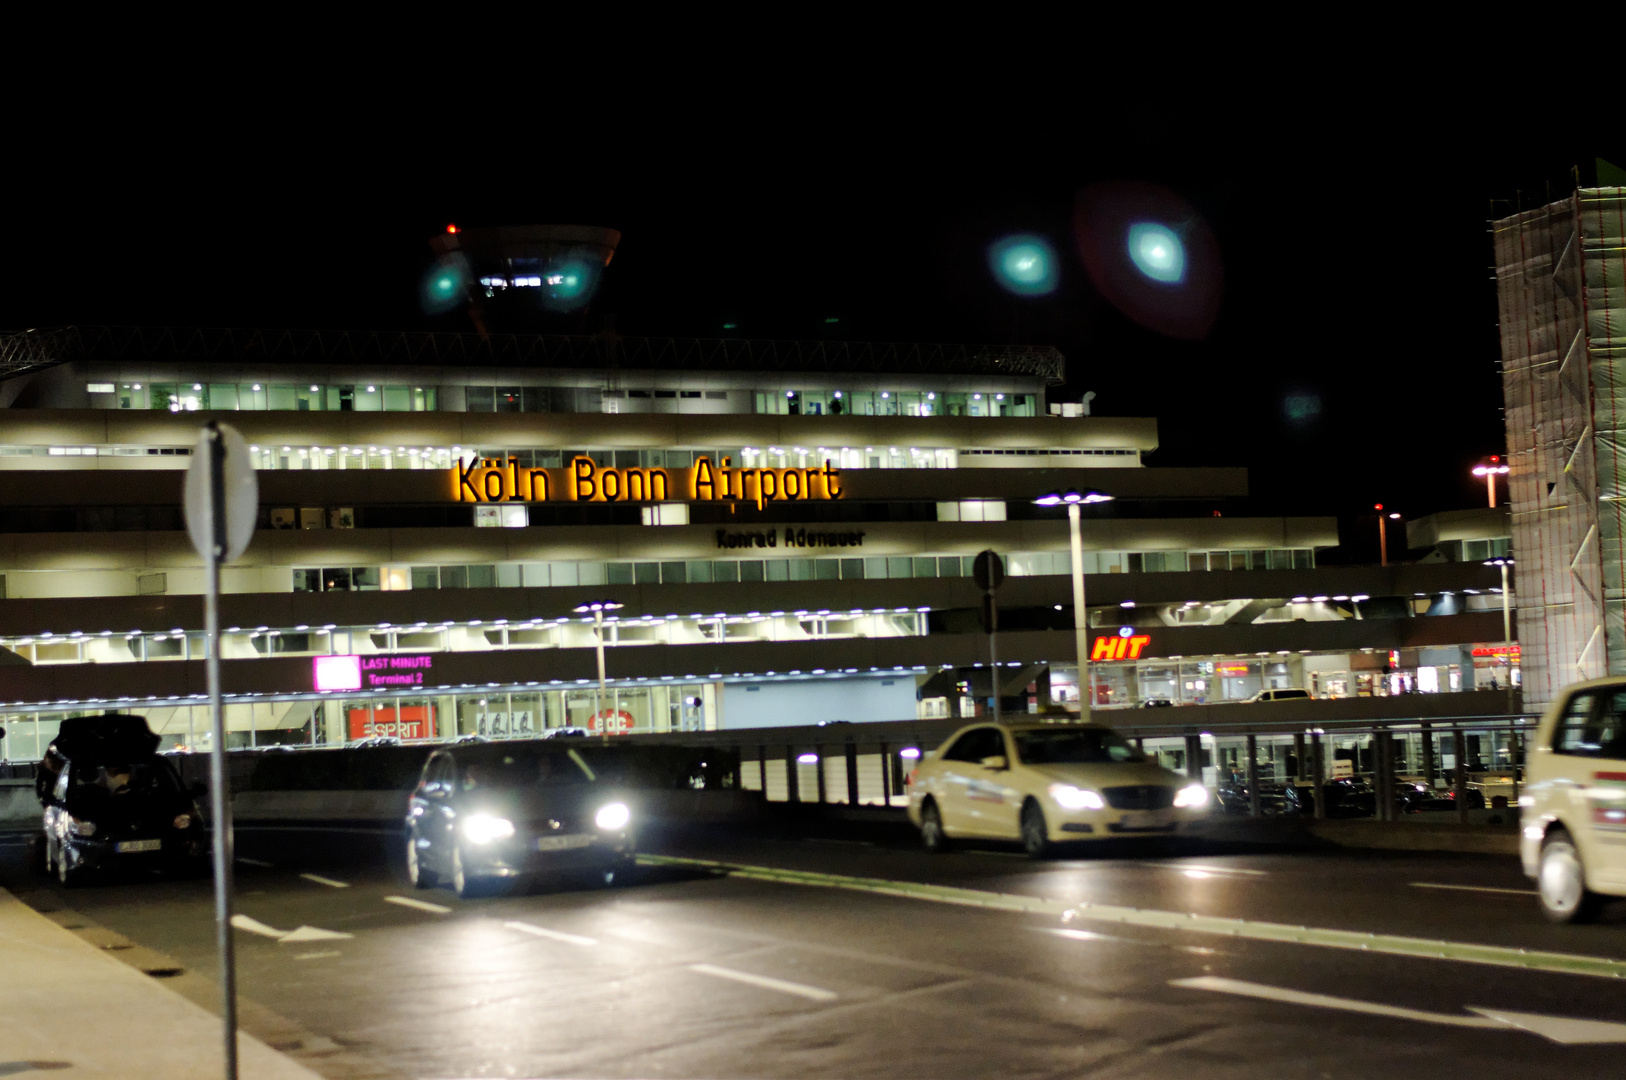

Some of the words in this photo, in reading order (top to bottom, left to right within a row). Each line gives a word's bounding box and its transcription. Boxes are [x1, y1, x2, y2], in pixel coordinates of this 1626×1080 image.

[456, 455, 551, 503] Köln
[572, 455, 669, 502] Bonn
[694, 455, 843, 512] Airport
[716, 528, 777, 549] Konrad
[785, 527, 866, 548] Adenauer
[362, 658, 389, 670] LAST
[390, 656, 432, 669] MINUTE
[368, 673, 414, 685] Terminal
[416, 673, 424, 684] 2
